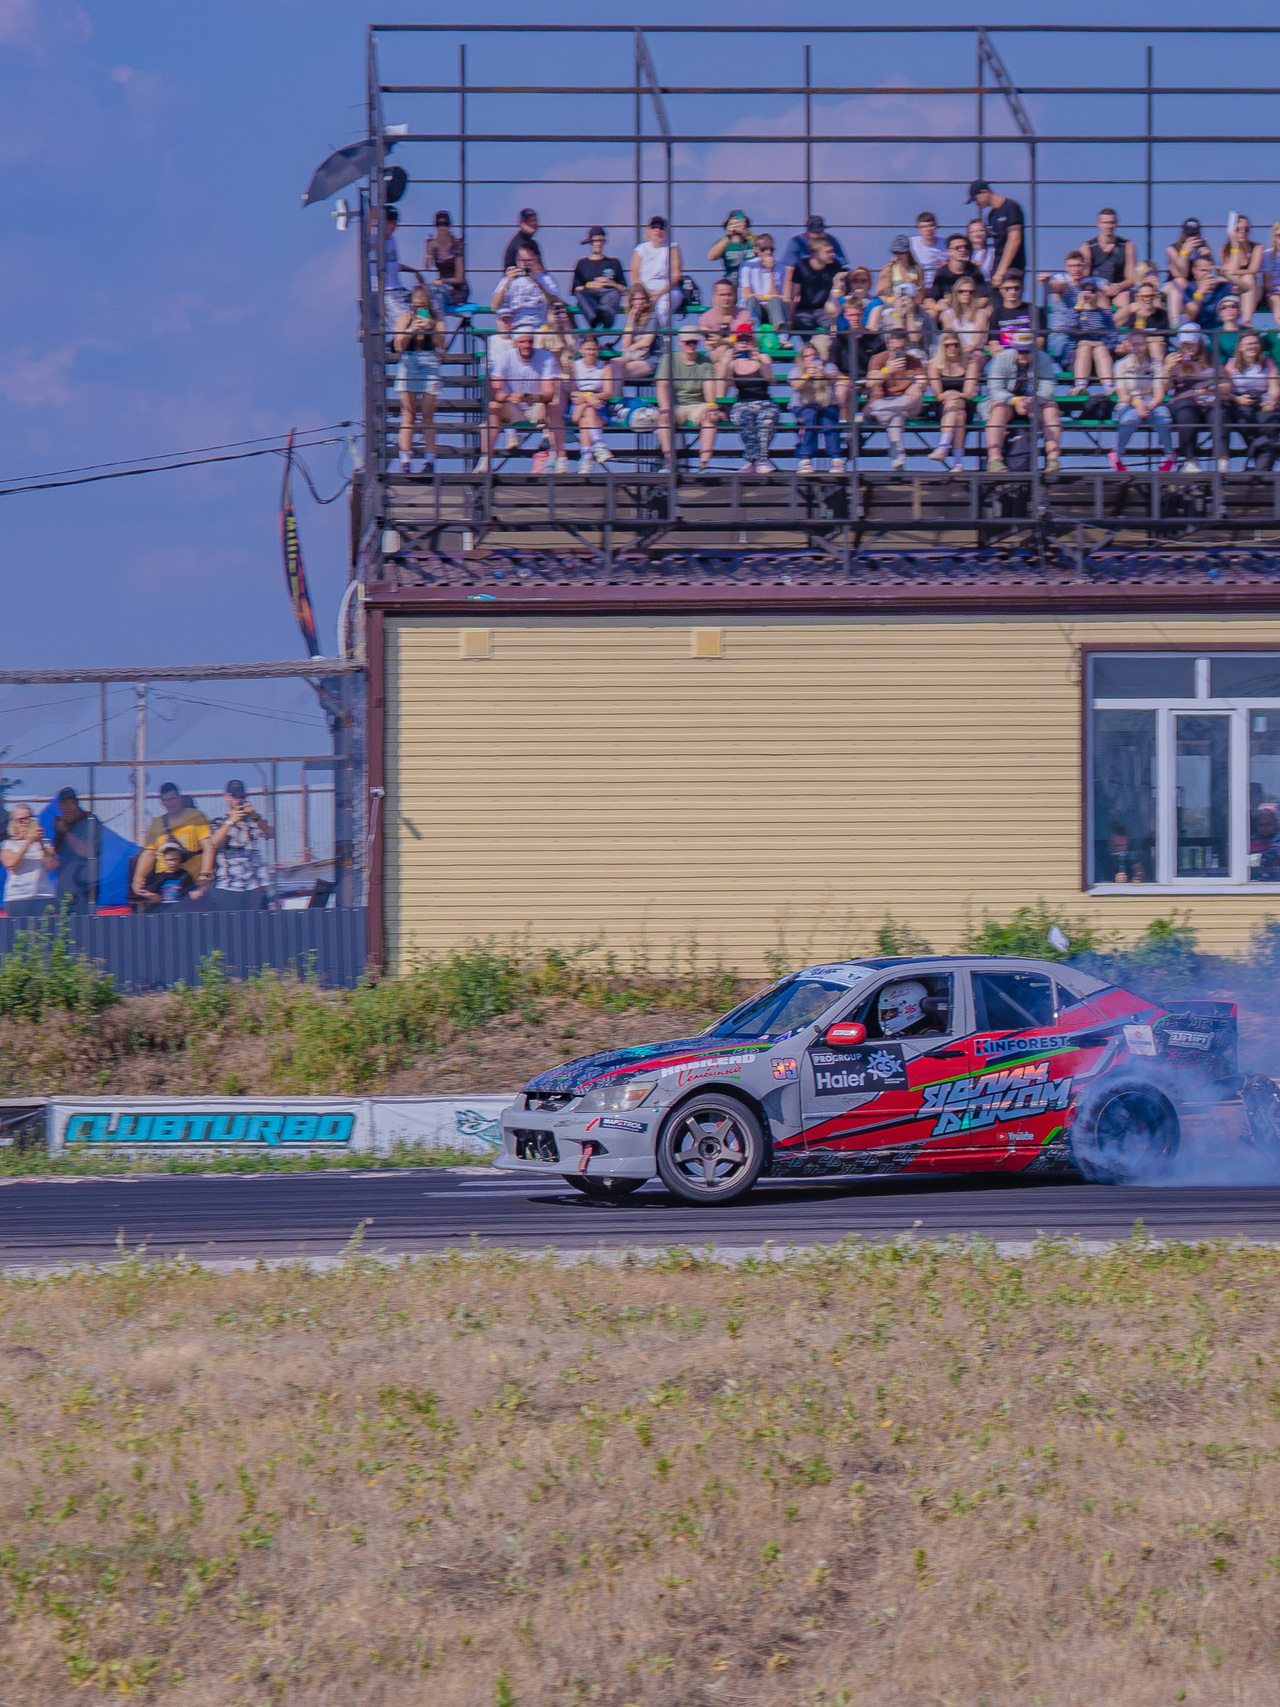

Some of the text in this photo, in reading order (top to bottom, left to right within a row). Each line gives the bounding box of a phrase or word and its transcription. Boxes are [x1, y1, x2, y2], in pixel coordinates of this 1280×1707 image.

[975, 1036, 1068, 1055] KINFOREST
[661, 1054, 756, 1078] HABILEAD
[770, 1057, 798, 1080] 33
[816, 1070, 865, 1089] Haier
[65, 1114, 355, 1145] CLUBTURBO
